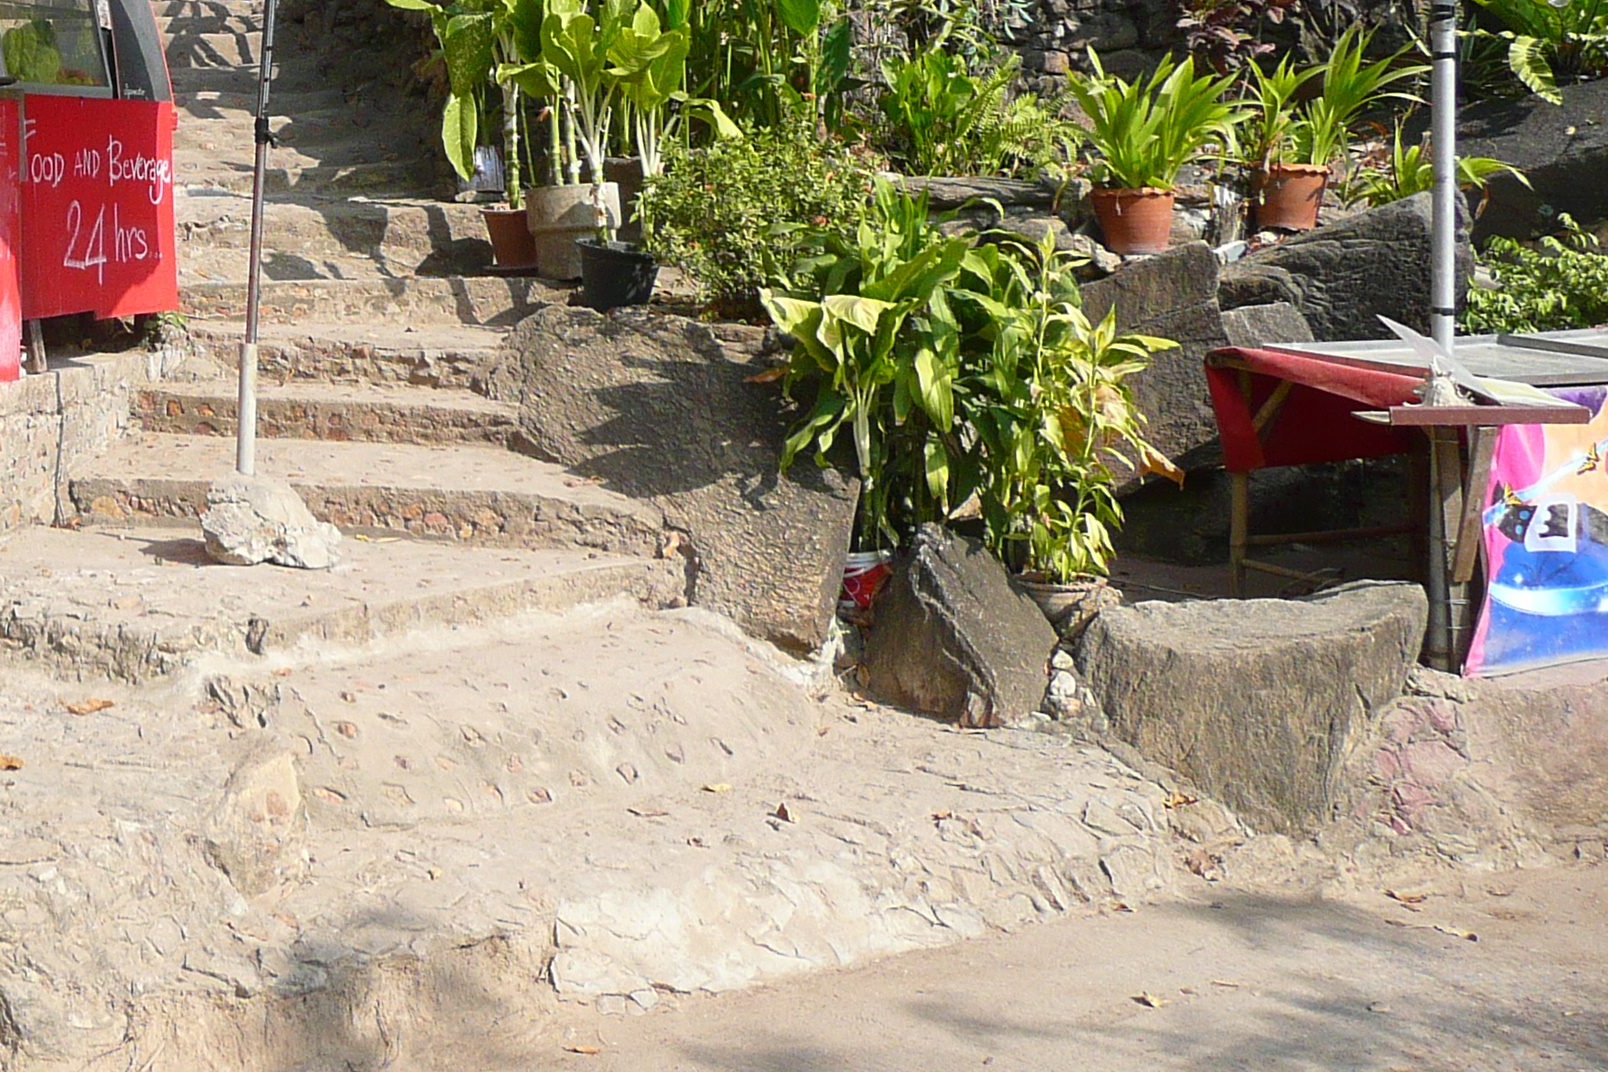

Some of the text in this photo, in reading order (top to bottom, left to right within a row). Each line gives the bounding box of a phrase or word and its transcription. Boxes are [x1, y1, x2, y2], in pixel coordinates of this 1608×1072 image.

[73, 147, 101, 179] AND
[107, 134, 170, 205] Beverage
[63, 200, 108, 286] 24
